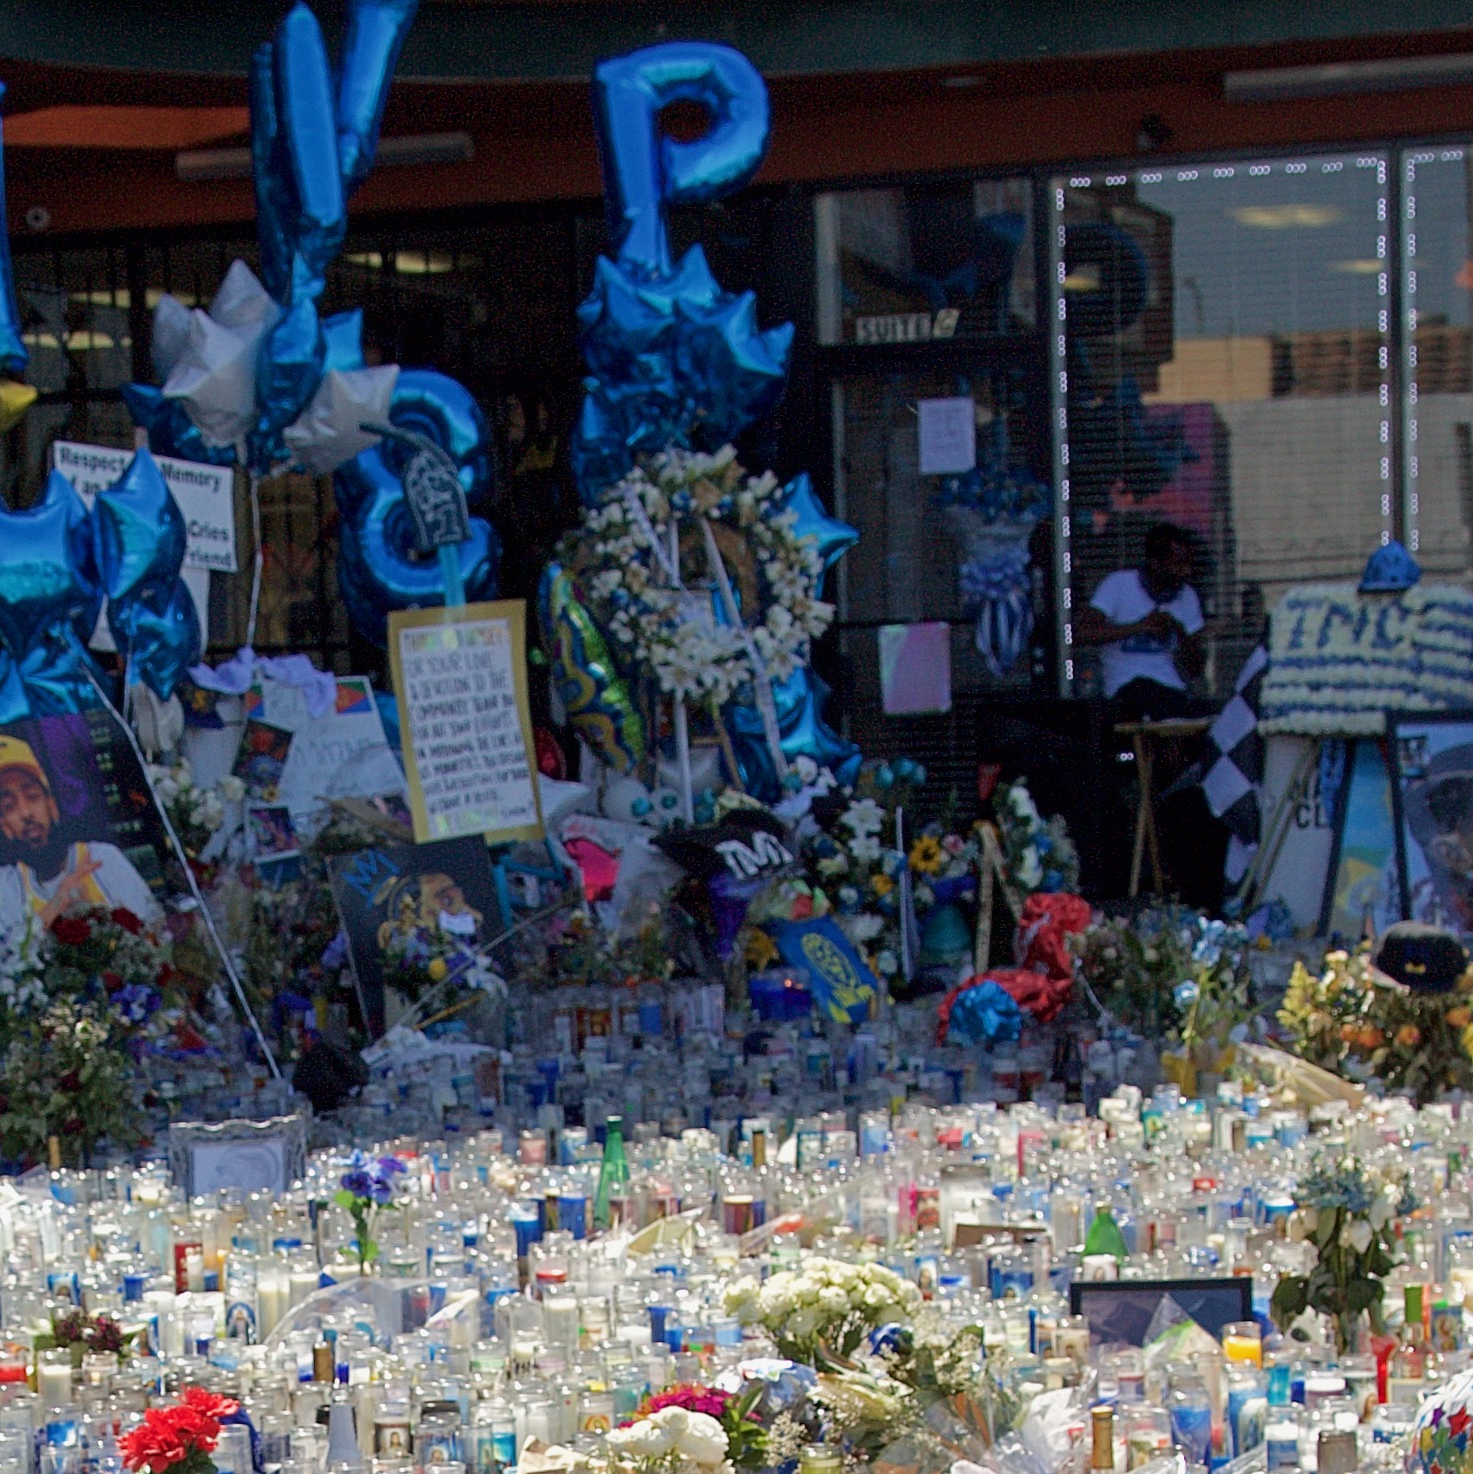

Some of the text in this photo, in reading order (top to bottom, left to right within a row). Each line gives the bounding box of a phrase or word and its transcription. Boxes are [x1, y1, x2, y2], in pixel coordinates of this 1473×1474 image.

[594, 40, 772, 282] P
[860, 316, 928, 343] SUITE
[59, 446, 223, 493] Respect Memory
[1286, 595, 1413, 651] TMC
